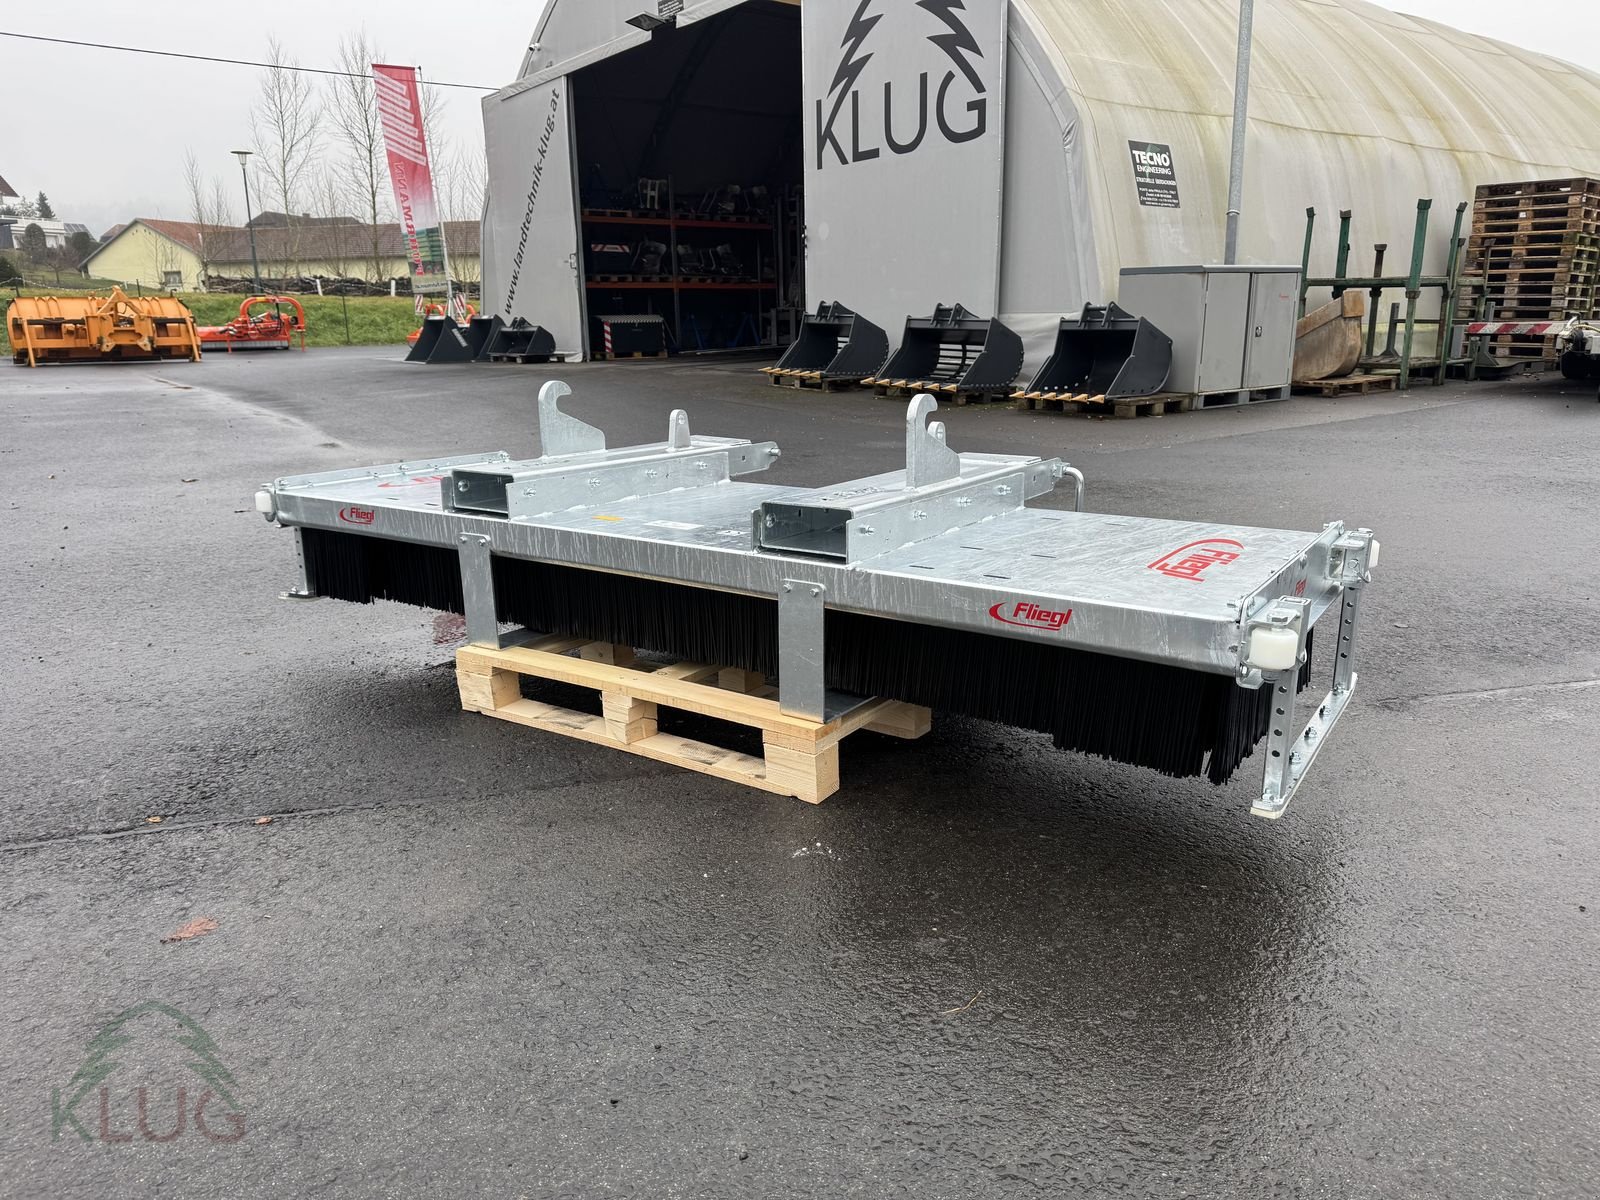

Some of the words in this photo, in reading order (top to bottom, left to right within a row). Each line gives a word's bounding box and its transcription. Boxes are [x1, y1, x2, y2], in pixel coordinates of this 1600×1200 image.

[816, 70, 987, 170] KLUG
[1132, 150, 1170, 167] TECNO
[1136, 165, 1172, 175] ENGINEERING
[504, 88, 560, 315] www.landtechnik-klug.at
[350, 507, 375, 522] Fliegl
[1156, 548, 1241, 582] Fliegl
[1013, 602, 1073, 628] Fliegl
